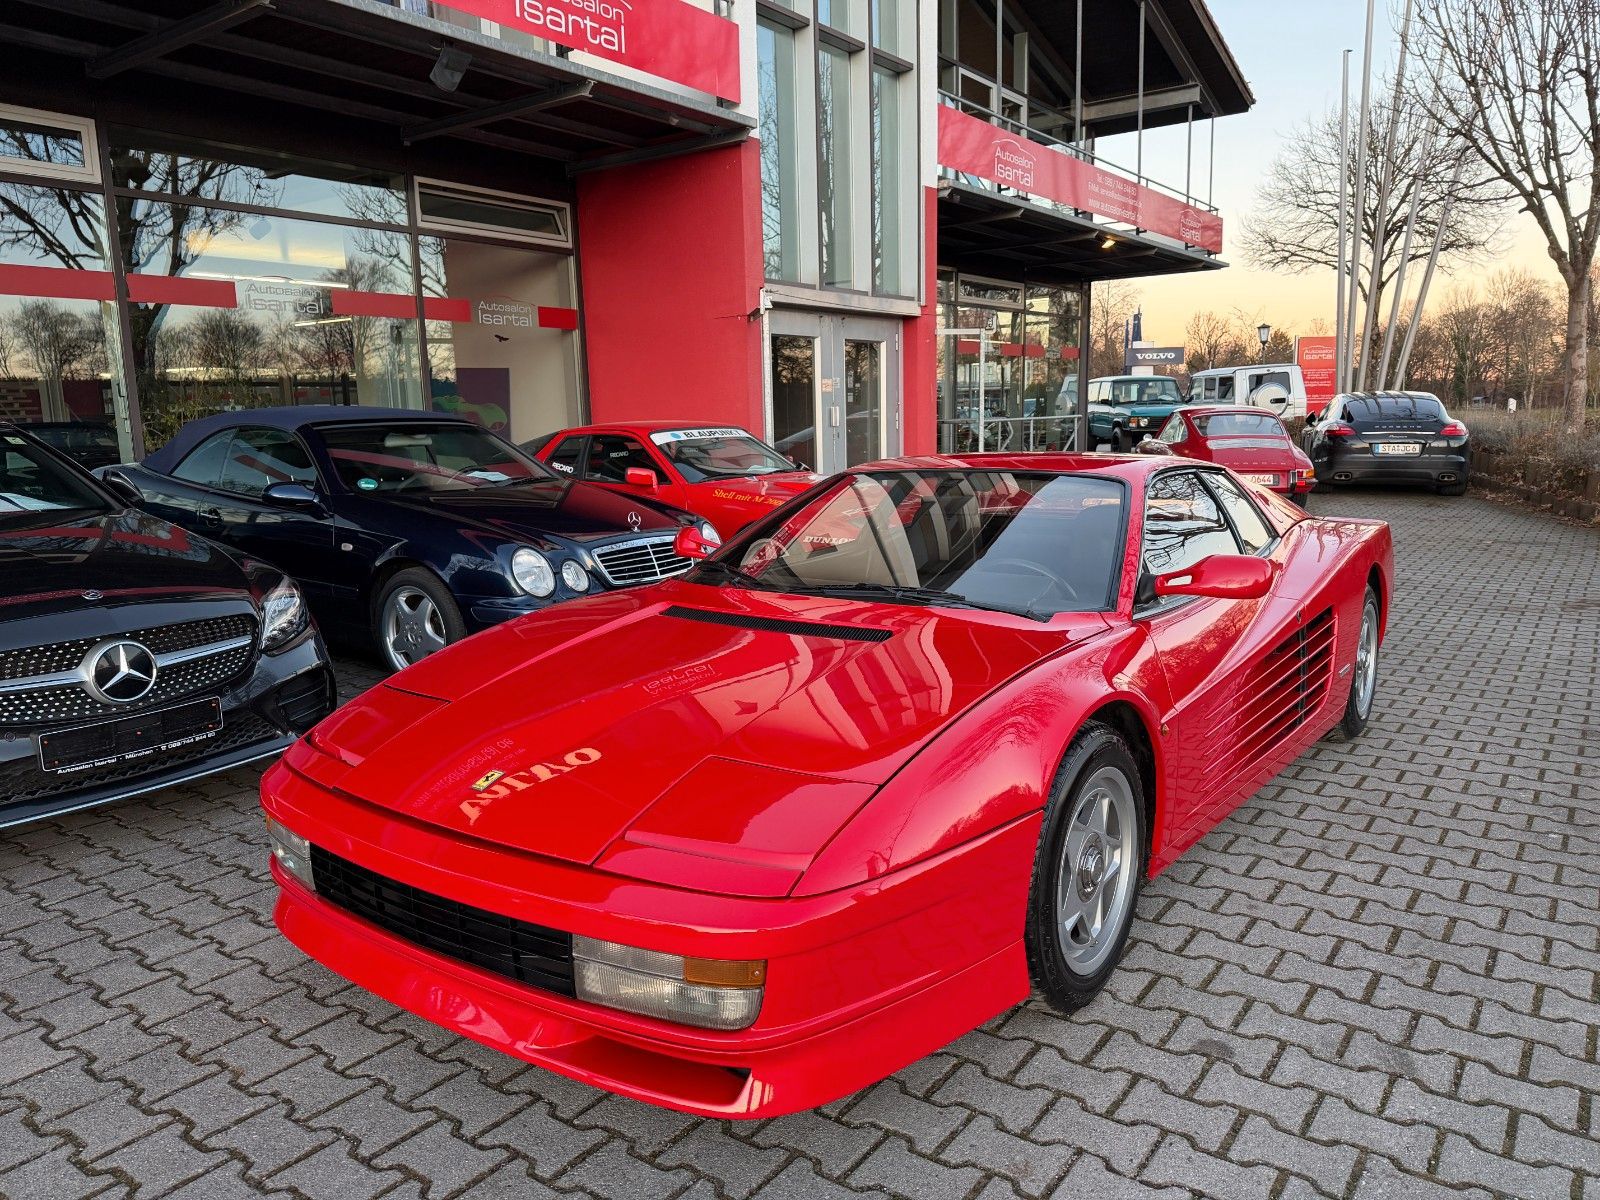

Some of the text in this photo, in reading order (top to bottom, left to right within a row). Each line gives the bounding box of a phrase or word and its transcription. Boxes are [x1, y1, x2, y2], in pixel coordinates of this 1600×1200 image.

[995, 146, 1034, 169] Autosalon
[994, 157, 1034, 187] Isartal
[245, 282, 322, 298] Autosalon
[245, 293, 324, 314] Isartal
[478, 300, 531, 313] Autosalon
[478, 309, 533, 327] Isartal
[1135, 352, 1176, 360] VOLVO
[683, 429, 741, 439] BLAUPUNKT
[551, 461, 574, 474] RECARO
[712, 488, 735, 499] Shell
